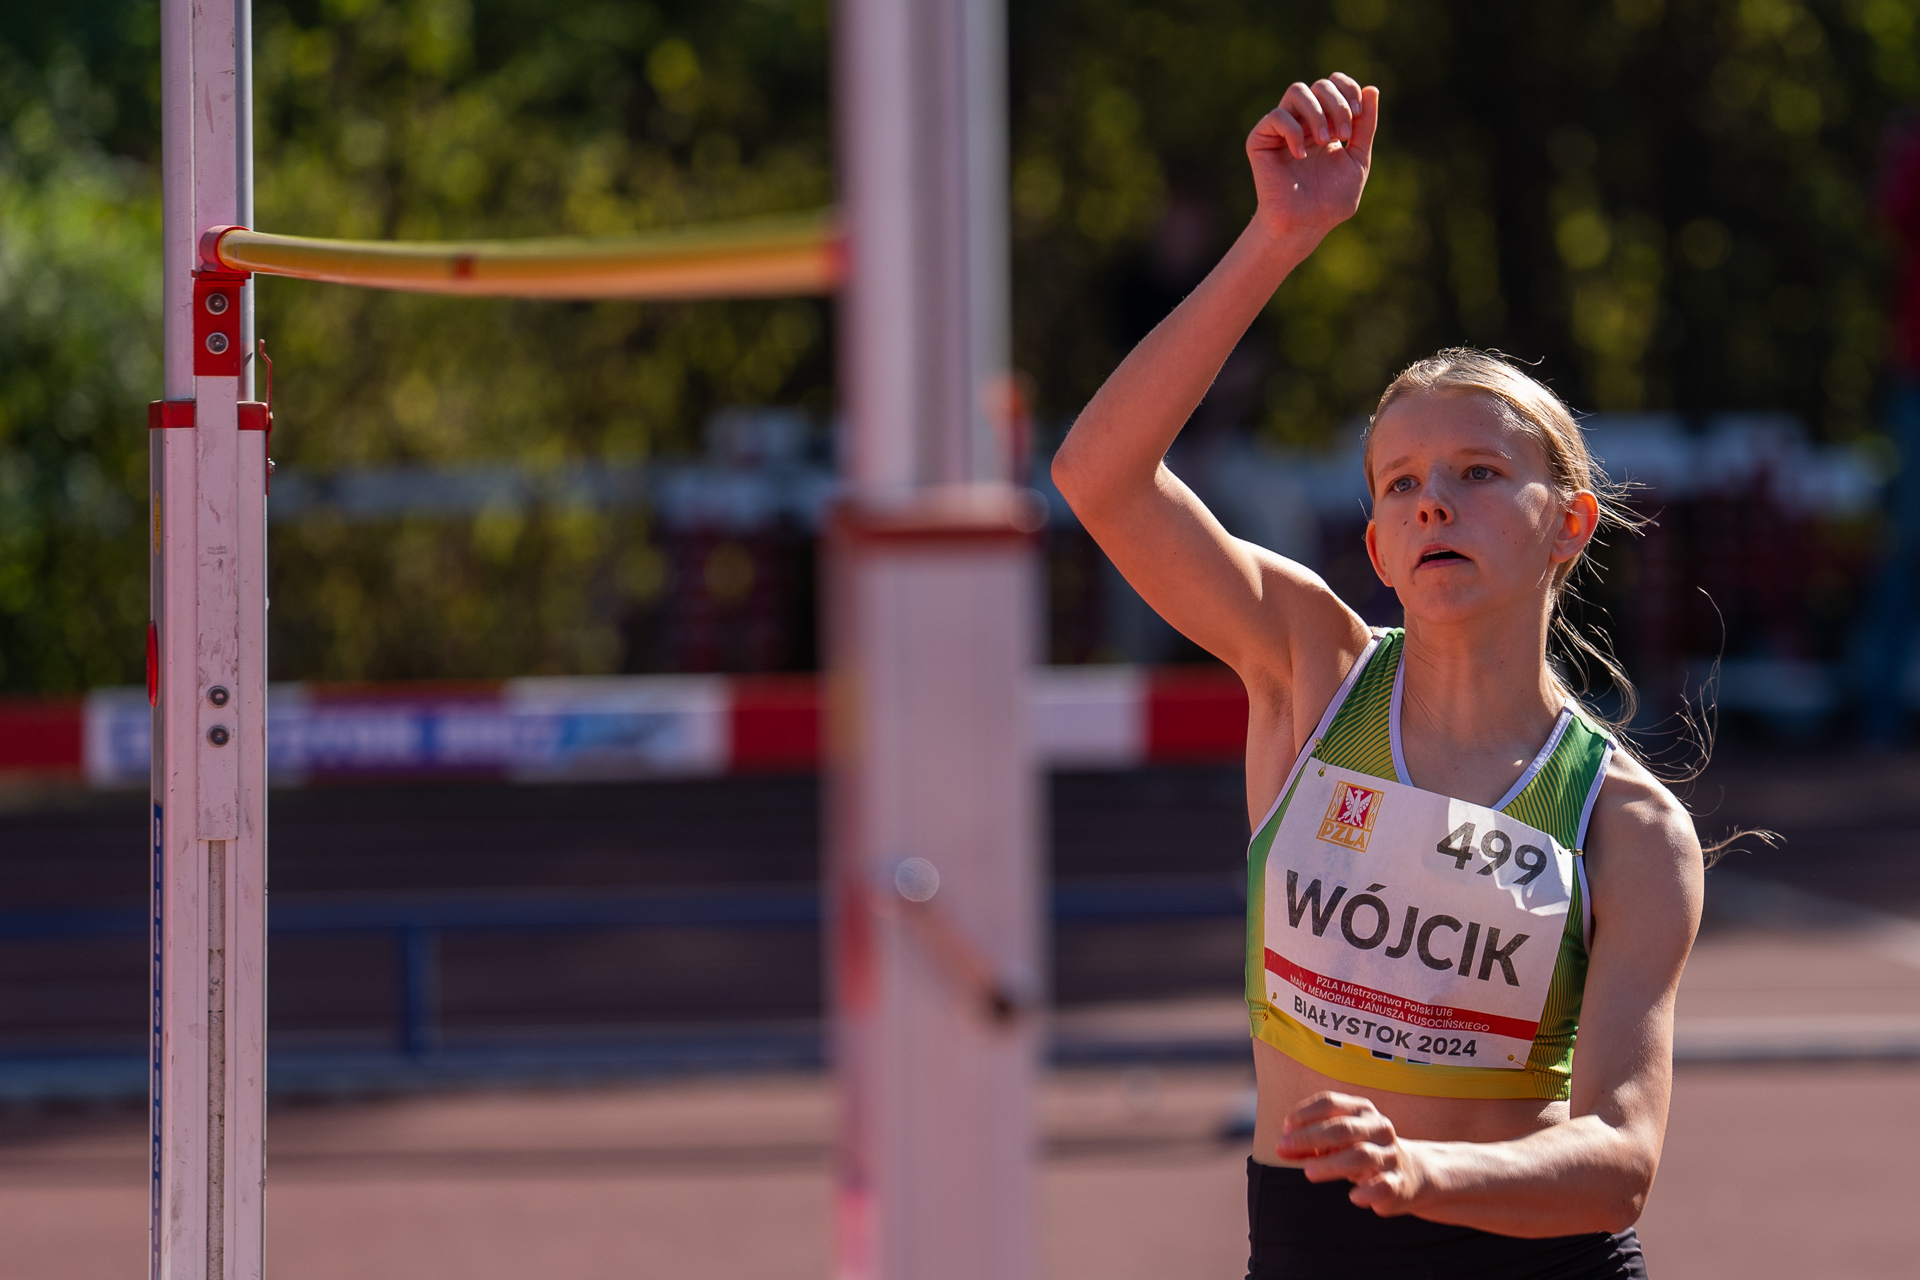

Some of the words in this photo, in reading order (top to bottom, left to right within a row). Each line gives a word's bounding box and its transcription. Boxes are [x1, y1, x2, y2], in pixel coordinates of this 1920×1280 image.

[1320, 820, 1366, 849] PZLA
[1437, 821, 1548, 886] 499
[1286, 869, 1531, 987] WÓJCIK
[1290, 974, 1307, 990] MAŁY
[1308, 984, 1356, 1008] MEMORIAŁ
[1358, 1000, 1405, 1020] JANUSZA
[1407, 1013, 1490, 1032] KUSOCIŃSKIEGO
[1294, 994, 1413, 1050] BIAŁYSTOK
[1417, 1035, 1477, 1057] 2024
[1316, 976, 1339, 991] PZLA
[1341, 983, 1402, 1007] Mistrzostwa
[1404, 1001, 1433, 1016] Polski
[1435, 1007, 1453, 1017] U16
